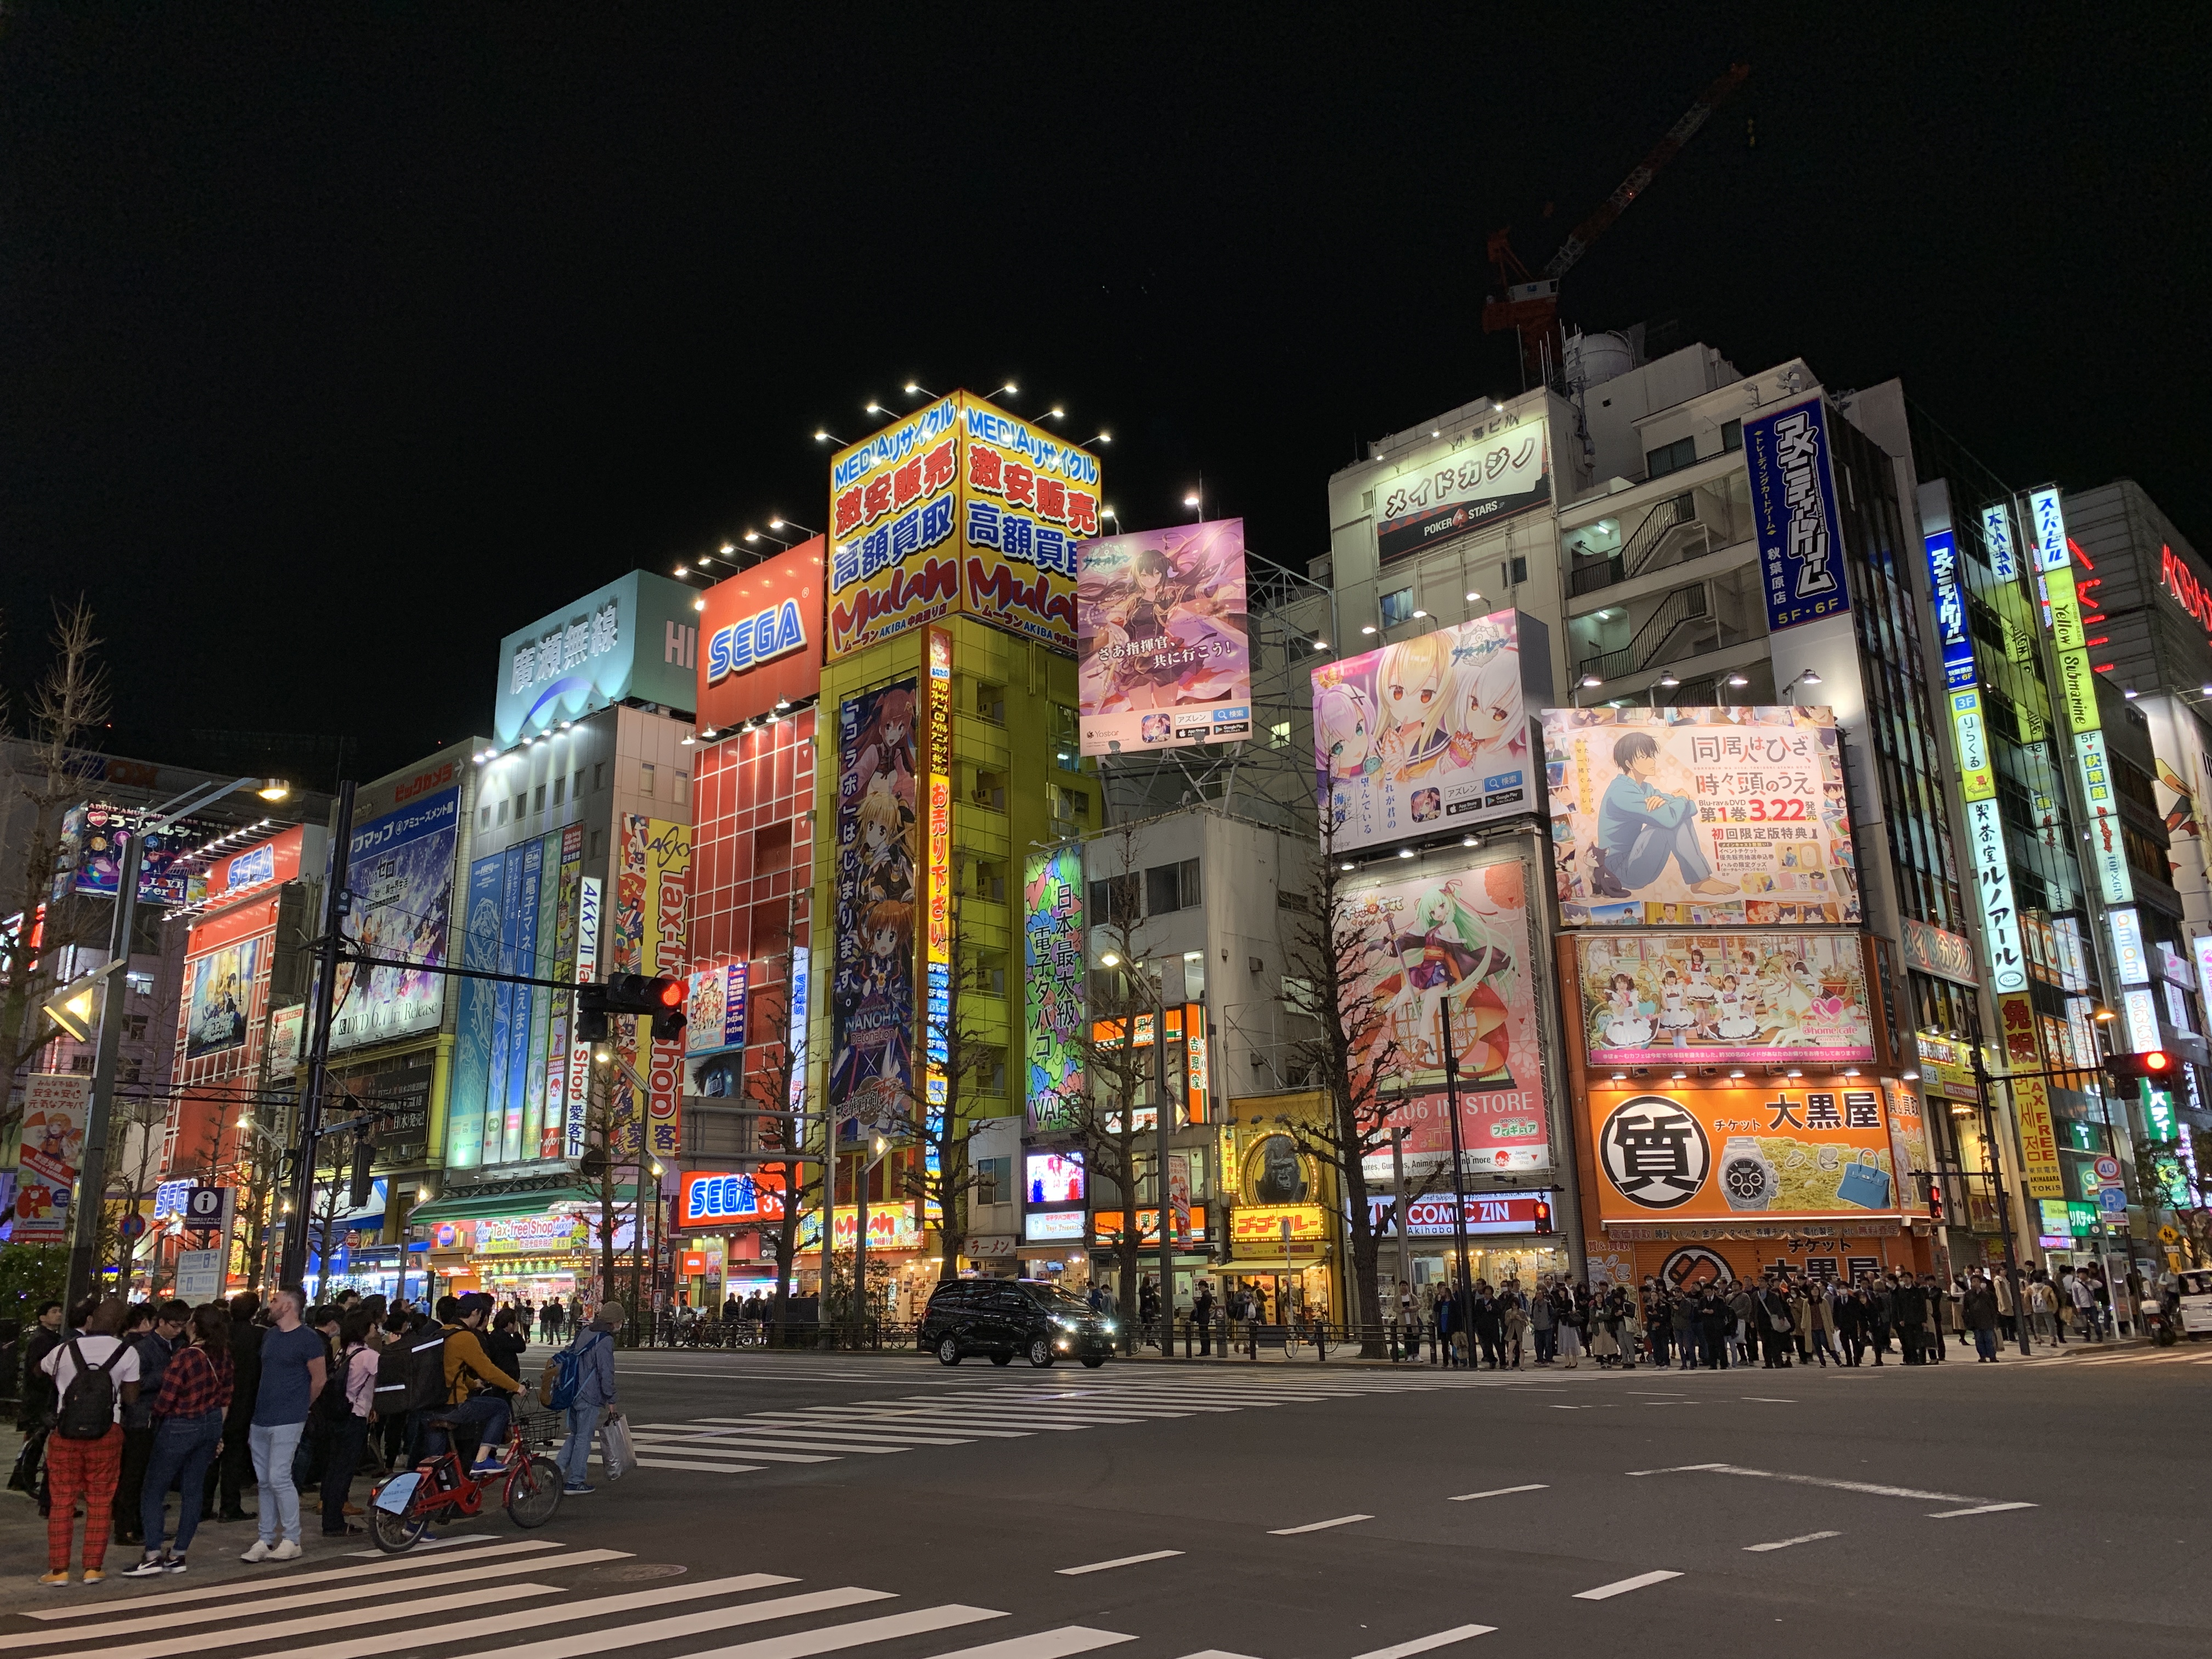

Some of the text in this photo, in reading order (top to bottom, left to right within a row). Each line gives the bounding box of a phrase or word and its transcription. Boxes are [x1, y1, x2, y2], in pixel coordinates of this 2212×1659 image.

[836, 442, 955, 536] 激安販売
[969, 445, 1096, 533] 激安販売
[1385, 437, 1534, 518] メイドカジノ
[1756, 437, 1776, 530] トレーディングカードゲーム
[1424, 518, 1453, 535] POKER
[2038, 497, 2064, 563] スーパービル
[833, 495, 953, 592] 高額買取
[1767, 547, 1787, 605] 秋葉原店
[832, 558, 958, 651] Mulan
[967, 557, 1077, 633] Mula
[843, 603, 947, 653] ムーラン AKIBA 中央通り店
[981, 606, 1053, 640] ムーラン AKIBA
[2055, 604, 2072, 645] Yellow
[707, 597, 807, 684] SEGA
[1098, 635, 1176, 662] さあ指揮官、
[932, 667, 949, 678] あなたの
[931, 691, 949, 704] ブルーレイ
[932, 680, 948, 692] DVD
[2064, 656, 2087, 725] Submarine
[931, 701, 949, 714] ゲーム
[1958, 698, 1974, 709] 3F
[931, 722, 948, 733] アイドル
[934, 713, 945, 723] CD
[1178, 709, 1244, 724] アズレン 検索
[931, 732, 948, 744] アニメ
[931, 743, 948, 754] コミック
[1691, 736, 1811, 763] 同居人はひざ、
[1964, 716, 1980, 768] りらくる
[2081, 732, 2096, 743] 5F
[931, 764, 947, 776] フィギュア
[932, 754, 947, 764] ホビー
[394, 762, 453, 803] ビックカメラ
[1448, 775, 1517, 798] アズレン 検索
[88, 802, 119, 814] ADULT
[1361, 776, 1372, 834] 望んでいる
[1385, 772, 1396, 829] これが君の
[1700, 806, 1747, 823] 第1巻
[1805, 801, 1817, 821] 発売
[1711, 827, 1808, 840] 初回限定版特典
[227, 843, 274, 895] SEGA
[510, 856, 520, 919] ゲームセンターを
[1975, 804, 2019, 966] 喫茶室ルノアール
[580, 881, 599, 940] AKKY
[1055, 883, 1075, 1029] 日本最大級
[1901, 922, 1973, 978] メイドカジノ
[2118, 913, 2141, 982] amiami
[794, 974, 806, 1015] SEGA
[928, 989, 936, 997] 5F
[1034, 925, 1052, 1058] 電子タバコ
[404, 1000, 437, 1022] Release
[844, 1007, 902, 1034] NANOHA
[928, 1014, 935, 1023] 4F
[851, 1028, 895, 1045] Detonation
[1802, 1025, 1858, 1035] @home cafe
[2002, 999, 2039, 1065] 免税
[927, 1039, 935, 1049] 3F
[569, 1048, 588, 1101] Shop
[1189, 1036, 1200, 1090] 吉野家
[1923, 1069, 1938, 1081] りらくる
[649, 1036, 683, 1118] hop
[28, 1099, 84, 1110] 元気なアキバ
[1031, 1092, 1081, 1123] VAPE
[1466, 1091, 1535, 1116] STORE
[1714, 1092, 1882, 1133] チケット 大黒屋
[1887, 1091, 1920, 1118] 質&買取
[1491, 1121, 1538, 1138] フィギュア
[1499, 1116, 1528, 1125] BROCCOLI
[2036, 1113, 2056, 1161] FREE
[1412, 1156, 1491, 1169] Anime more
[1614, 1111, 1703, 1195] 質
[2029, 1166, 2058, 1174] 東京電気
[2030, 1175, 2060, 1183] AKIHABARA
[2100, 1163, 2115, 1173] 40
[689, 1172, 758, 1220] SEGA
[1435, 1193, 1457, 1202] Support
[1237, 1215, 1318, 1234] ゴーゴーカレー
[1408, 1204, 1476, 1224] COMIC
[1481, 1201, 1510, 1222] ZIN
[2069, 1210, 2096, 1227] リバティー
[530, 1219, 554, 1235] Shop
[1610, 1228, 1651, 1240] 高価買取
[1655, 1229, 1671, 1239] 時計
[1756, 1227, 1798, 1237] 各種チケット
[1802, 1226, 1835, 1236] 電化製品
[1858, 1224, 1899, 1235] 無料査定
[519, 1238, 554, 1250] 歓迎光臨免税店
[969, 1239, 1010, 1255] ラーメン
[1607, 1240, 1630, 1251] 買取
[1788, 1238, 1852, 1254] チケット
[1763, 1257, 1882, 1289] 大黒屋
